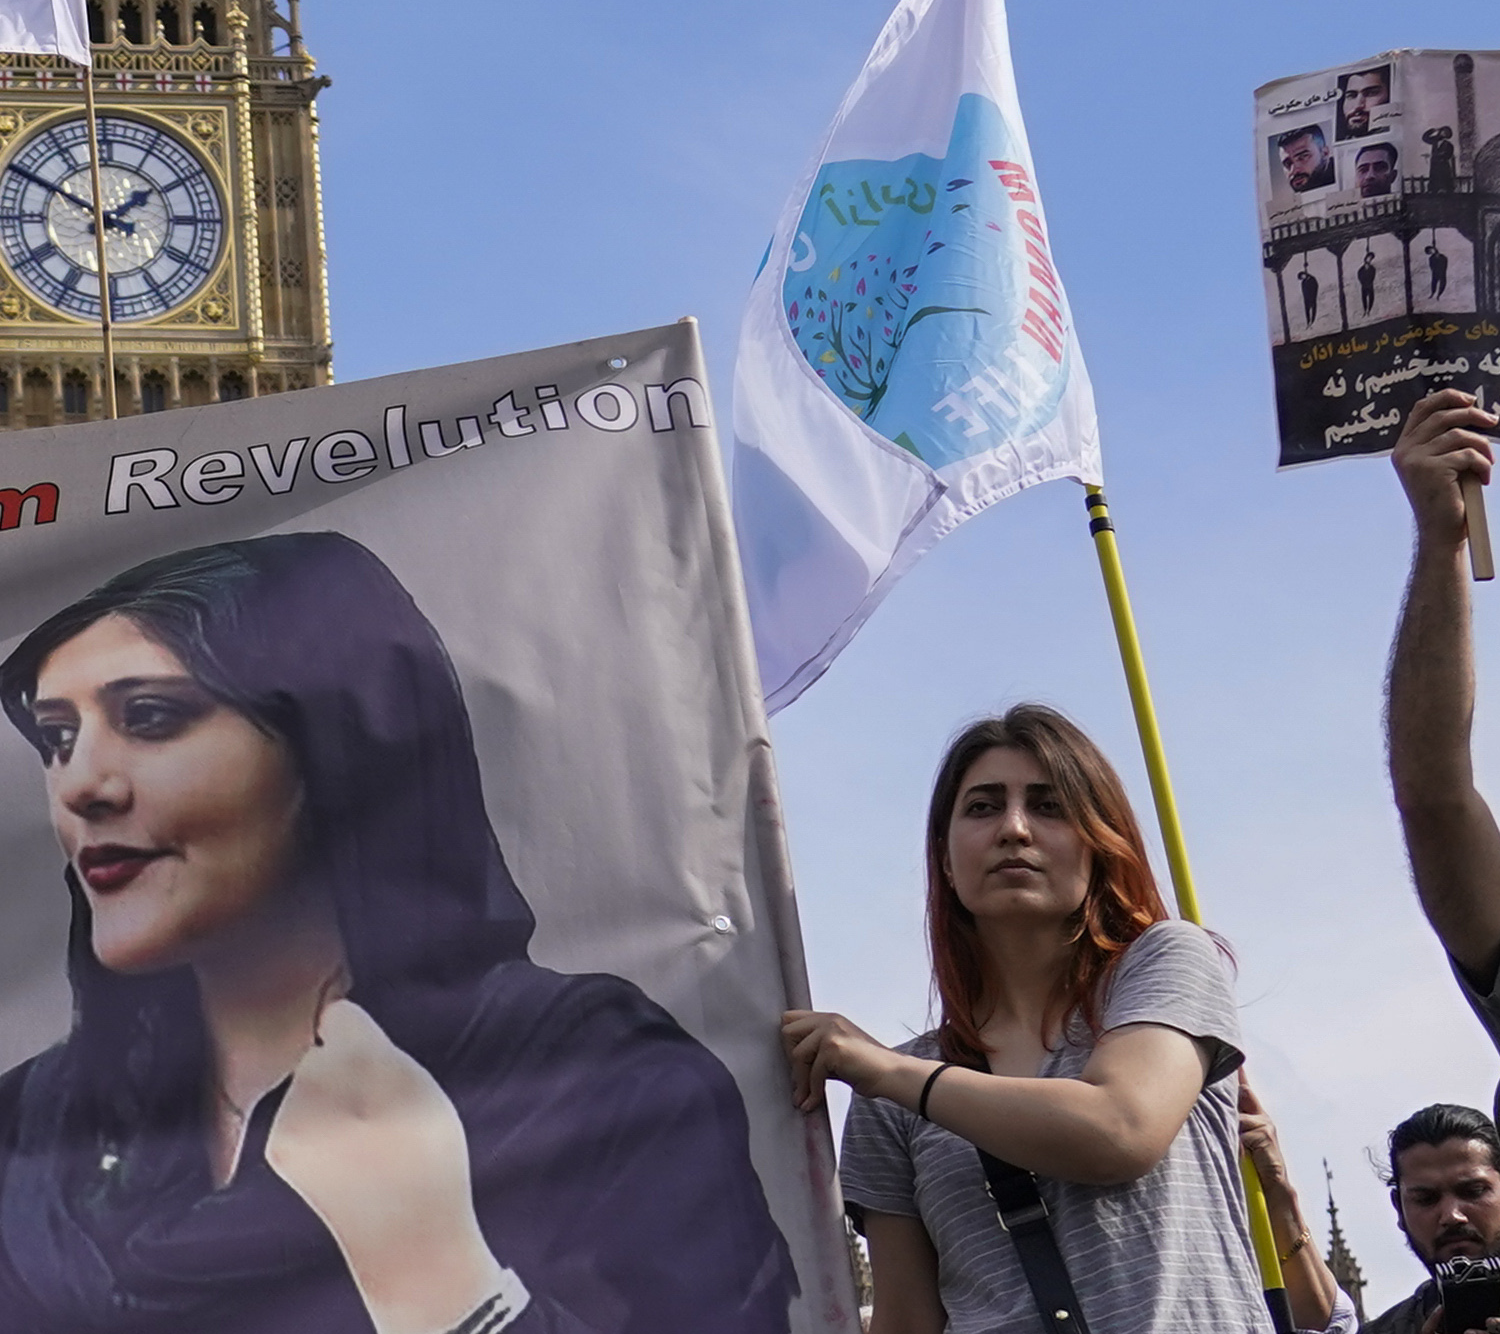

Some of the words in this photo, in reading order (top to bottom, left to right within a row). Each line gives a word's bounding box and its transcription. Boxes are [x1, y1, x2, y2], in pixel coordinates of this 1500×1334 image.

[1303, 93, 1322, 108] های
[1393, 319, 1460, 348] حکومتی
[1464, 319, 1499, 341] های
[1337, 336, 1369, 357] سایه
[1373, 332, 1389, 355] در
[1322, 368, 1348, 399] نه
[1324, 401, 1402, 450] میکنیم
[104, 372, 711, 518] Revelution
